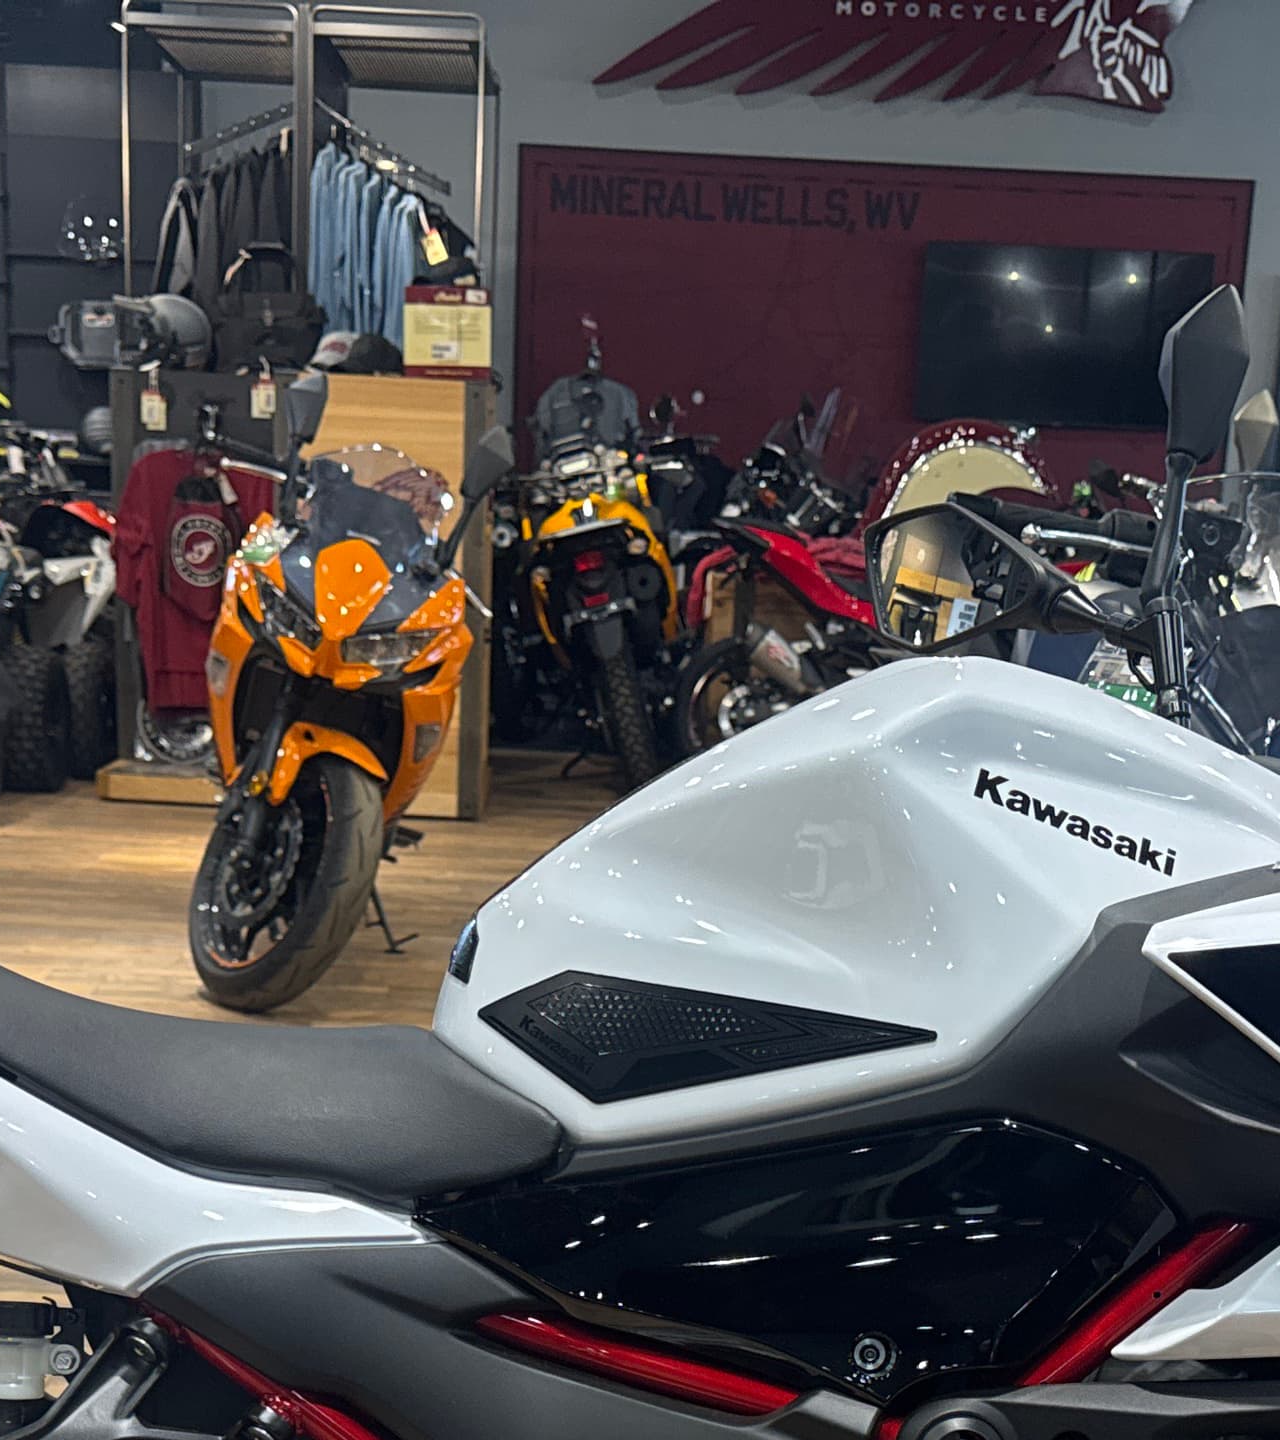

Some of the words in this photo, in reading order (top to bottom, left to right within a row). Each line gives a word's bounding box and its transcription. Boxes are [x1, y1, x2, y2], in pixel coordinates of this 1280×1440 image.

[835, 1, 1048, 23] MOTORCYCLE
[550, 173, 717, 222] MINERAL
[722, 183, 856, 233] WELLS,
[864, 189, 922, 230] WV
[973, 767, 1177, 877] Kawasaki
